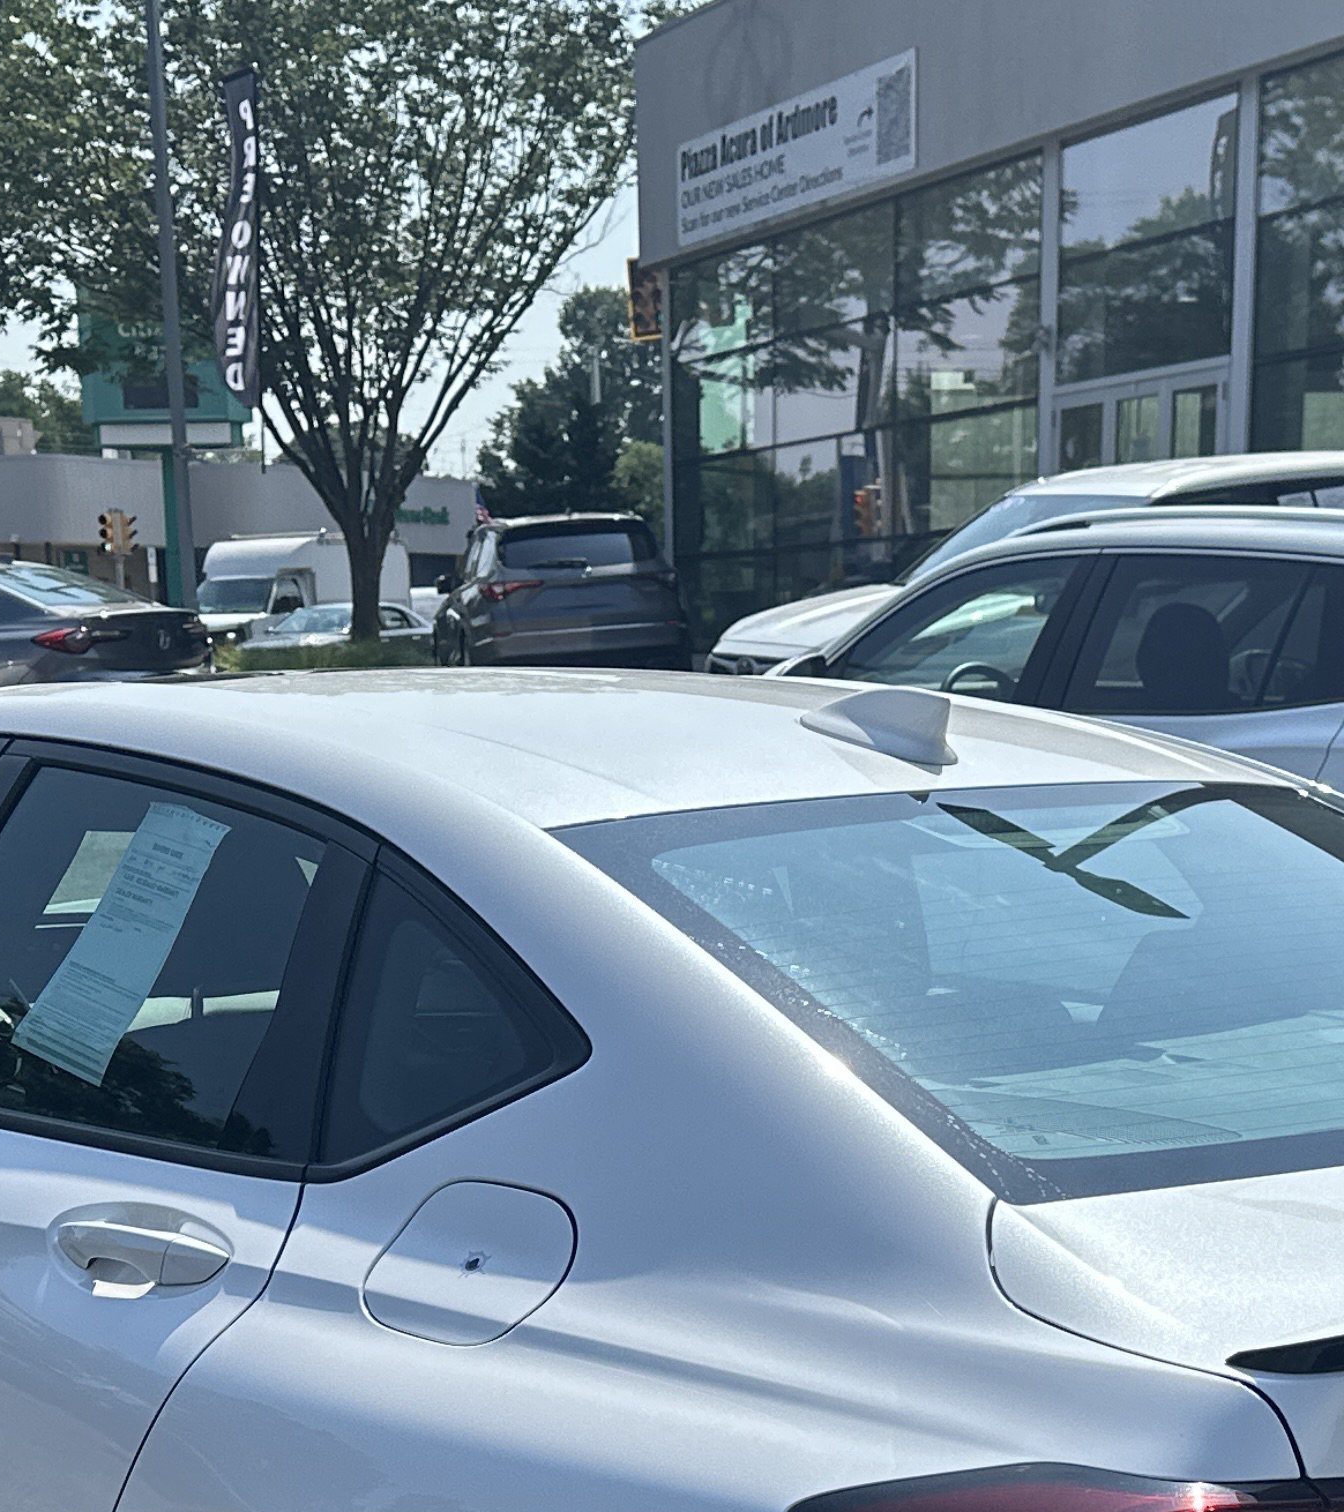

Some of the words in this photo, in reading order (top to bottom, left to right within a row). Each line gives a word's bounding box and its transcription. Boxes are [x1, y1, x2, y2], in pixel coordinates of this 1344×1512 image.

[680, 141, 718, 182] Piazza
[720, 127, 758, 167] Acura
[759, 113, 775, 151] of
[775, 95, 839, 145] Ardmore
[680, 186, 701, 209] OUR
[703, 178, 724, 201] NEW
[726, 166, 753, 193] SALES
[754, 154, 786, 180] HOME
[741, 192, 770, 213] Service
[771, 183, 798, 203] Center
[799, 166, 843, 193] Directions
